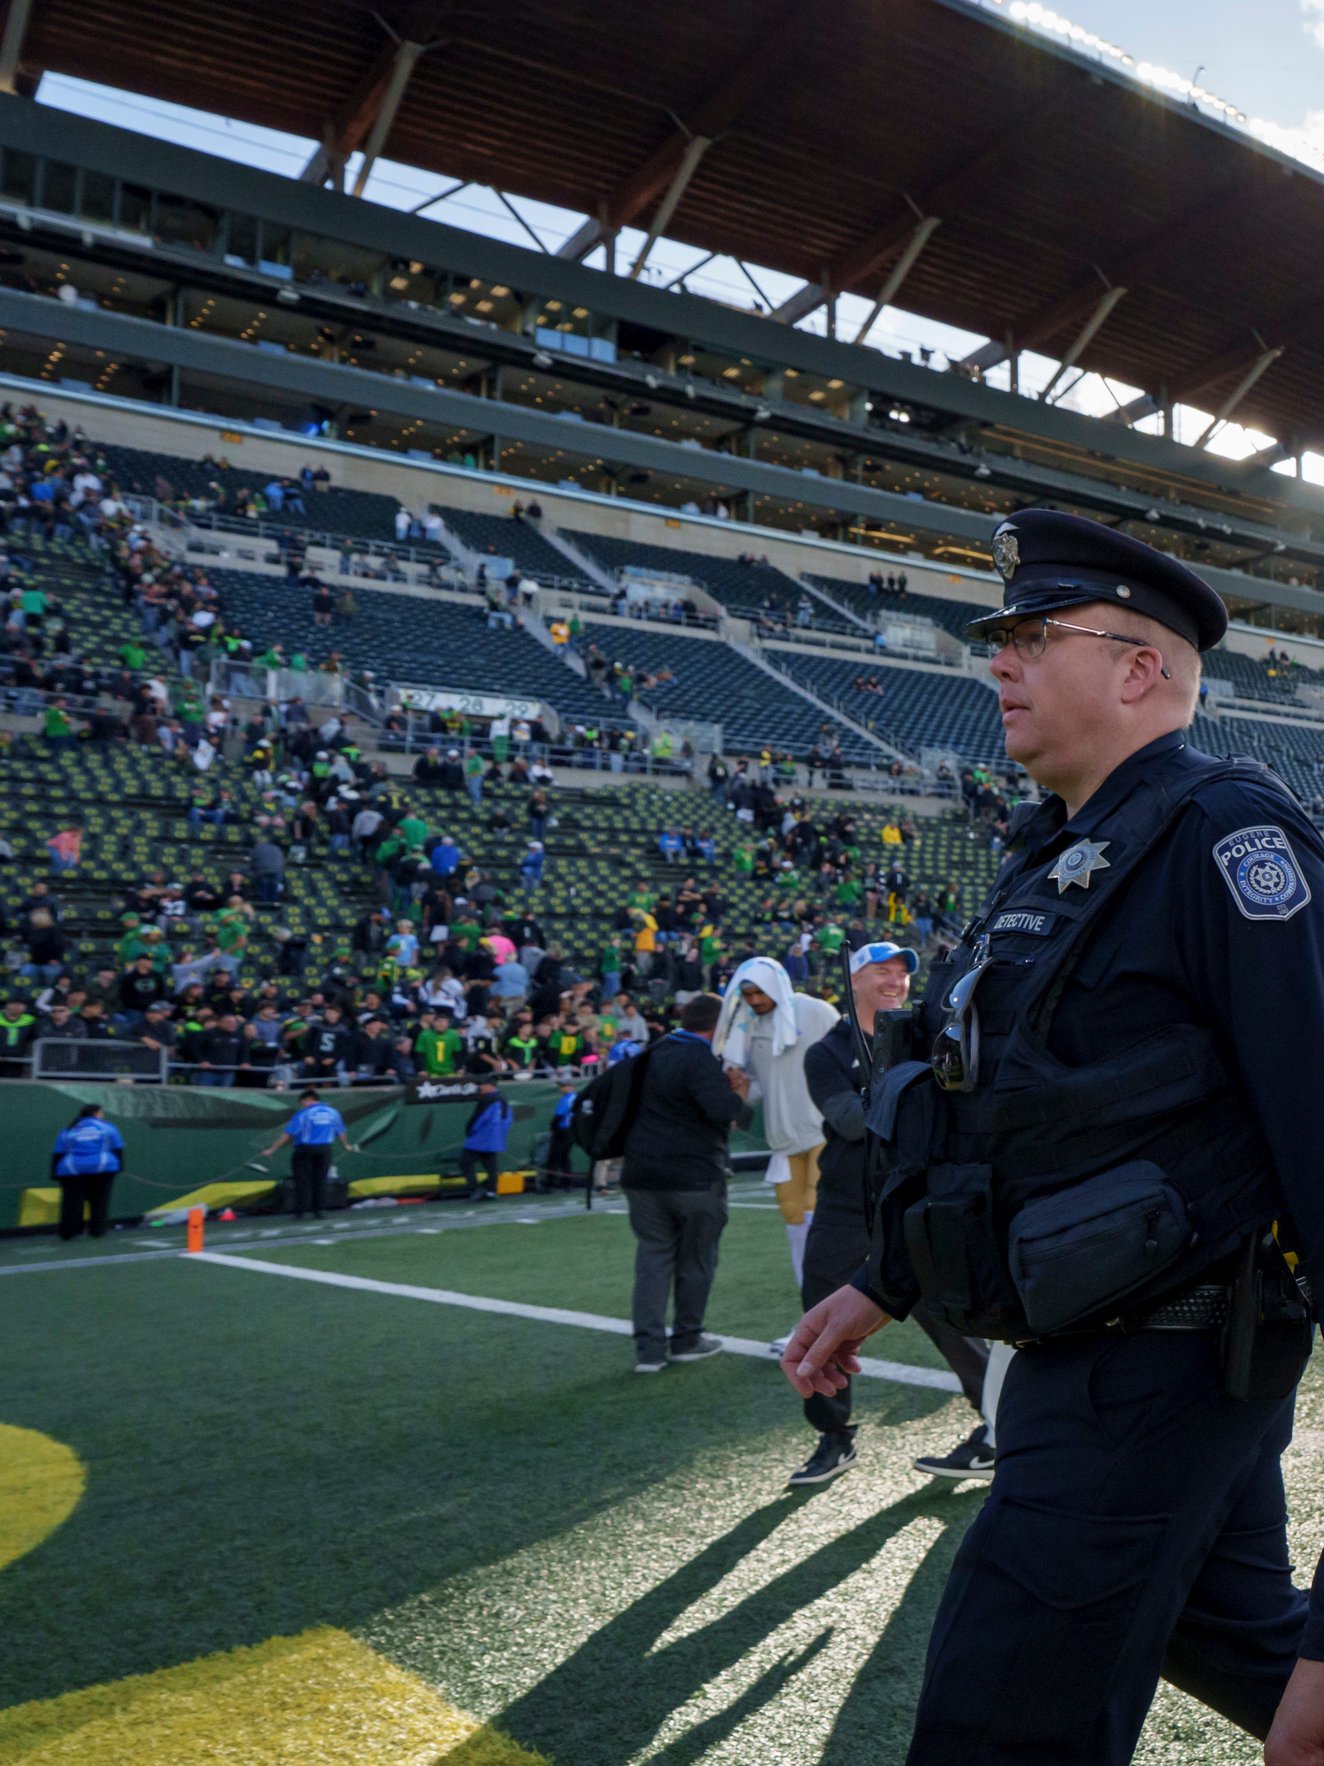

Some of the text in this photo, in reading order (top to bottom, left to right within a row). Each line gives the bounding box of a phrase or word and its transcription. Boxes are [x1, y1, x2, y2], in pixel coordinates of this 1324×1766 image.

[459, 695, 483, 714] 28
[1228, 830, 1270, 846] EUGENE
[1221, 837, 1286, 866] POLICE
[1243, 852, 1275, 867] COURAGE
[1240, 880, 1273, 903] INTEGRITY
[993, 913, 1045, 931] DETECTIVE
[320, 1033, 335, 1051] 5
[436, 1041, 445, 1062] 1
